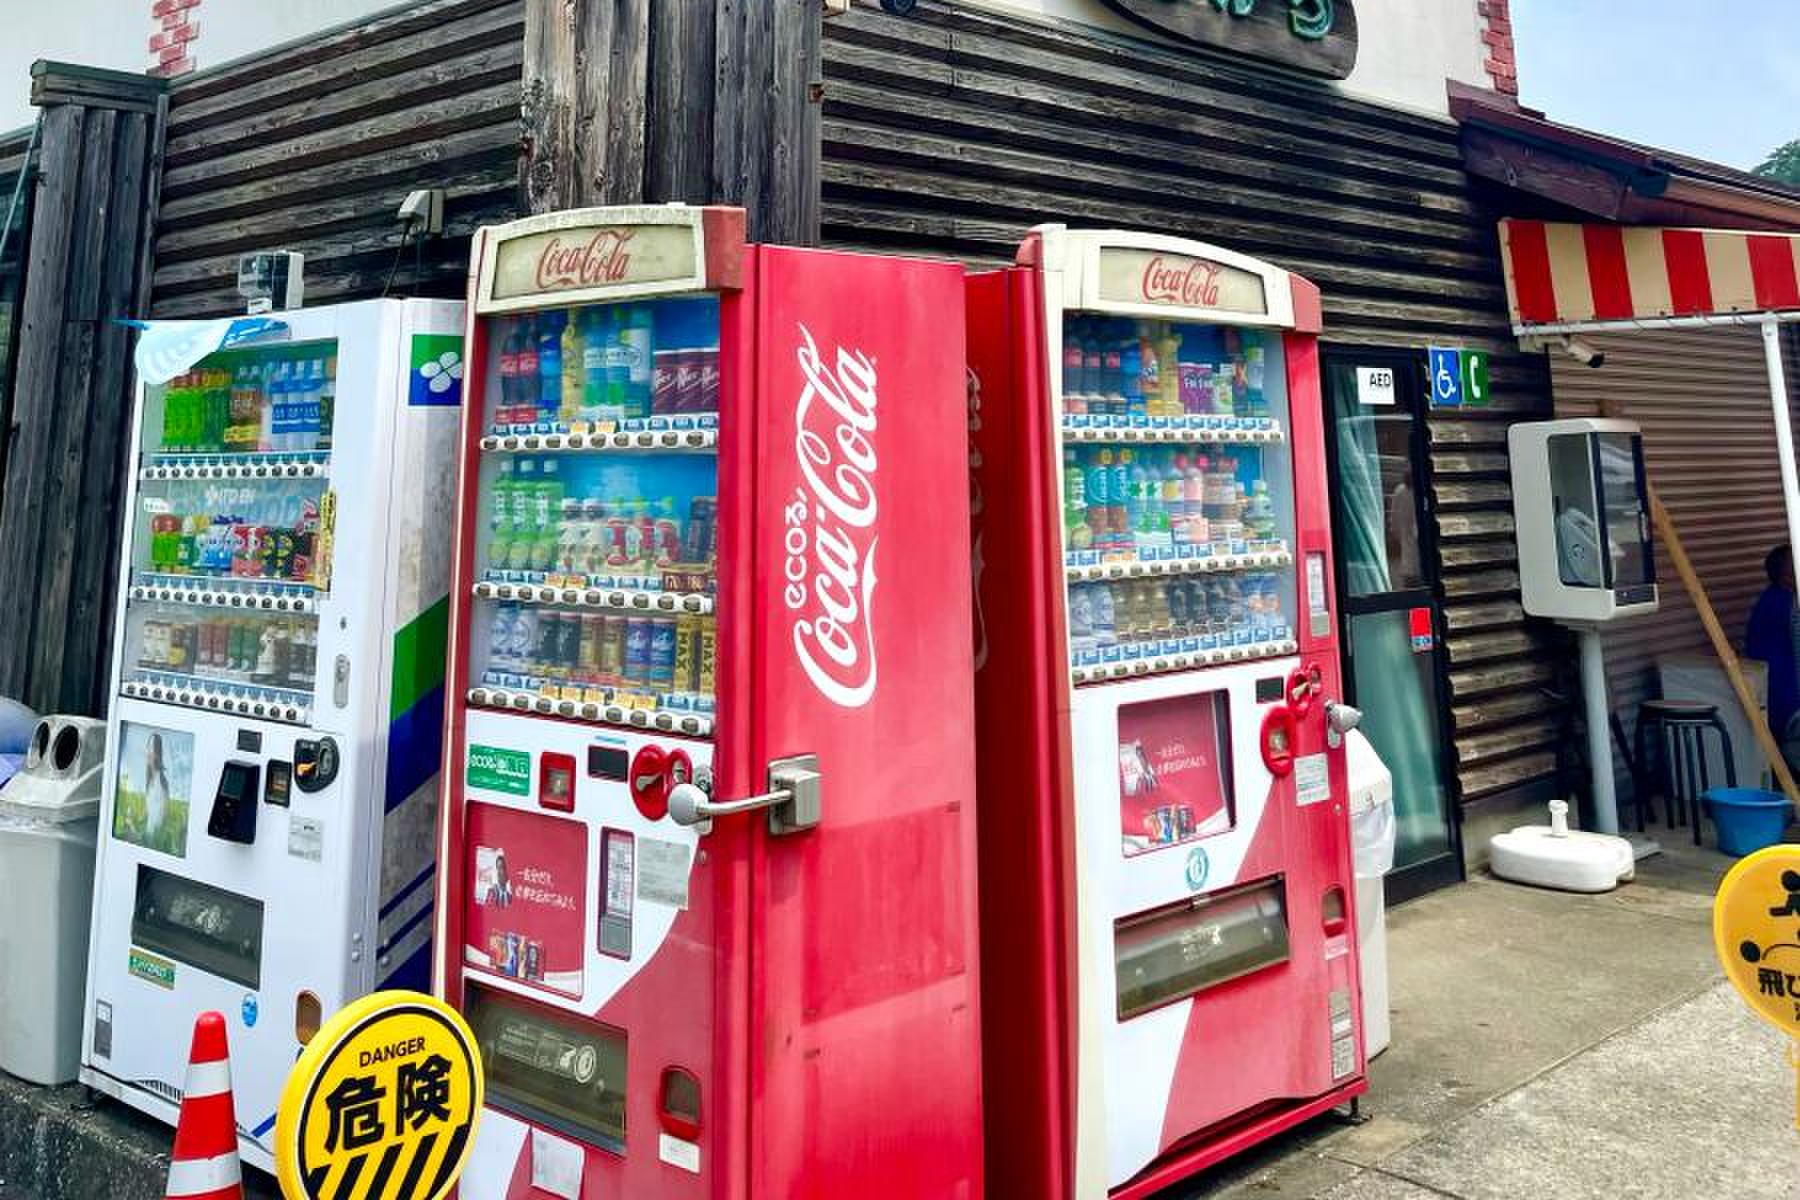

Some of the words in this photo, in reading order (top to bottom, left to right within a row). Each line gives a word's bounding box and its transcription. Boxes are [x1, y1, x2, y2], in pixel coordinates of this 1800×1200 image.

[1370, 372, 1392, 387] AED
[359, 1037, 426, 1068] DANGER
[324, 1053, 452, 1155] 危険
